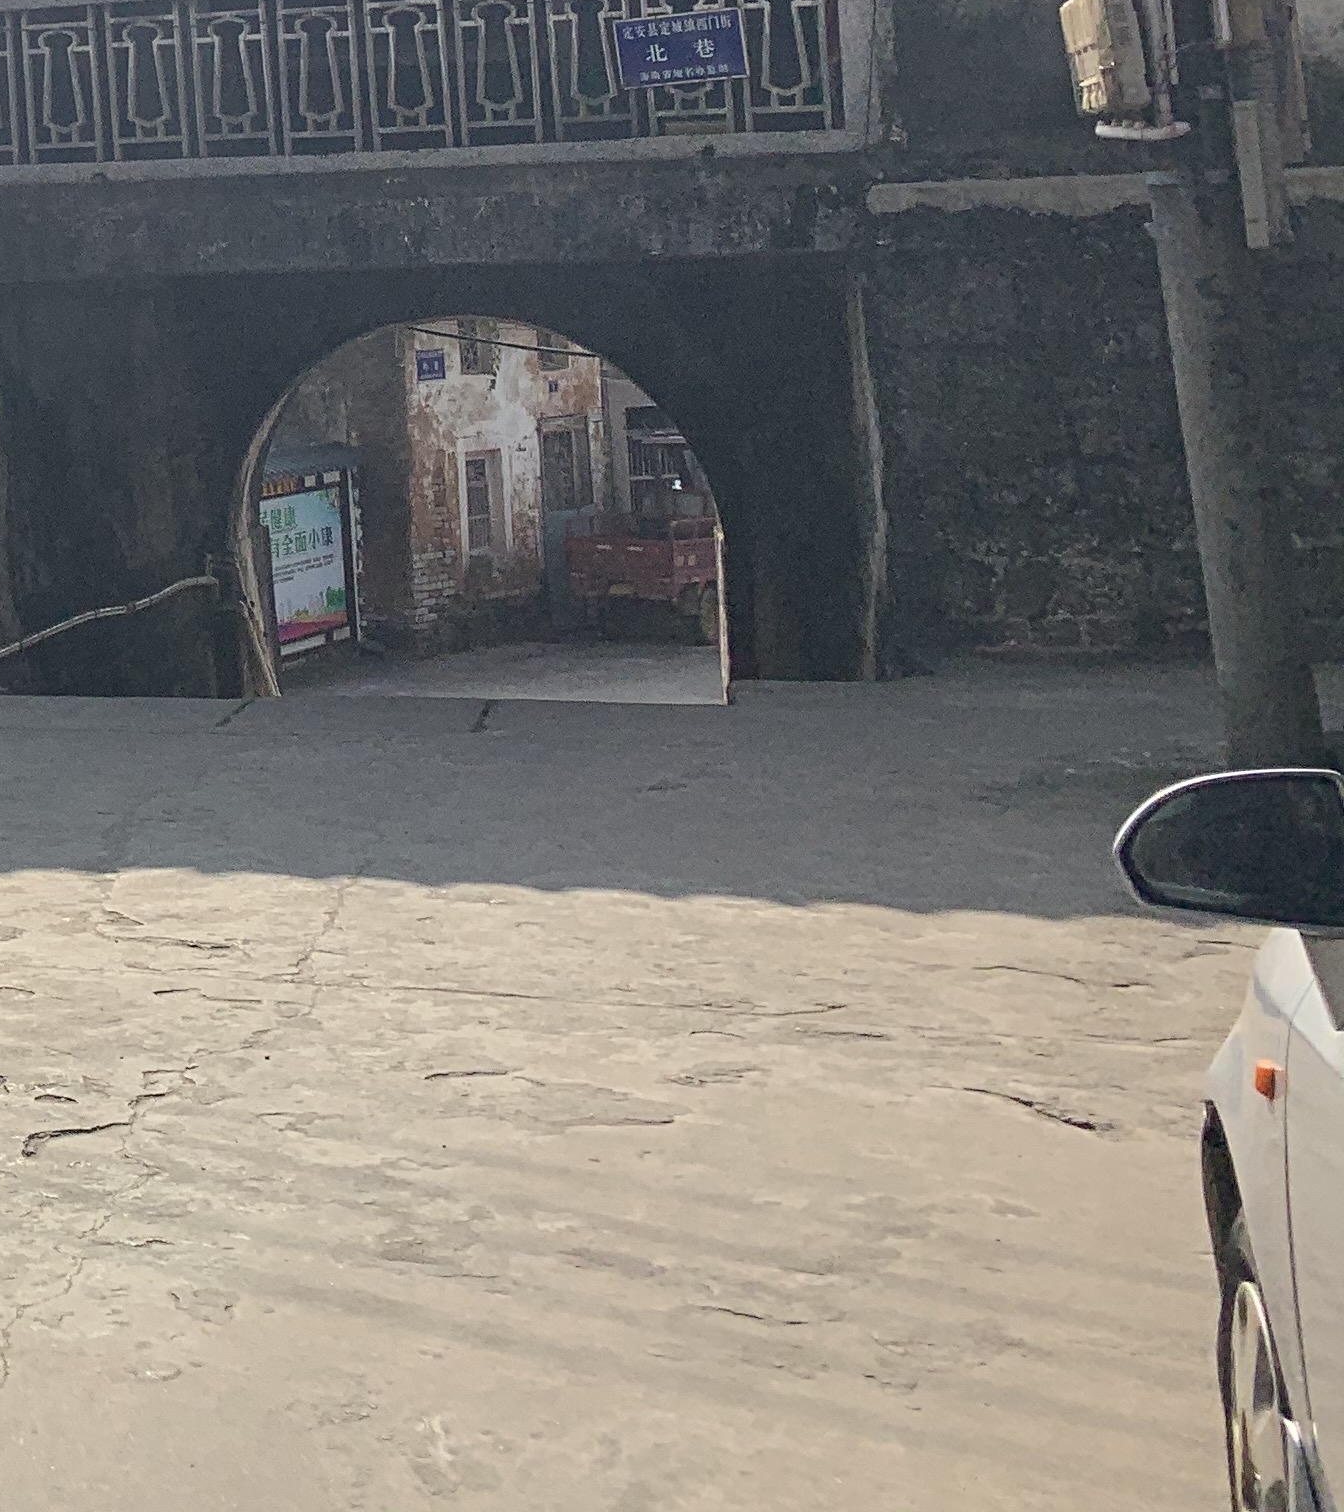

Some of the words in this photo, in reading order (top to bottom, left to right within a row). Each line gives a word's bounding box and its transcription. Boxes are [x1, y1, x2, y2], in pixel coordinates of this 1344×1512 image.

[622, 14, 732, 39] 定安县定城镇西门街
[645, 38, 715, 62] 北巷
